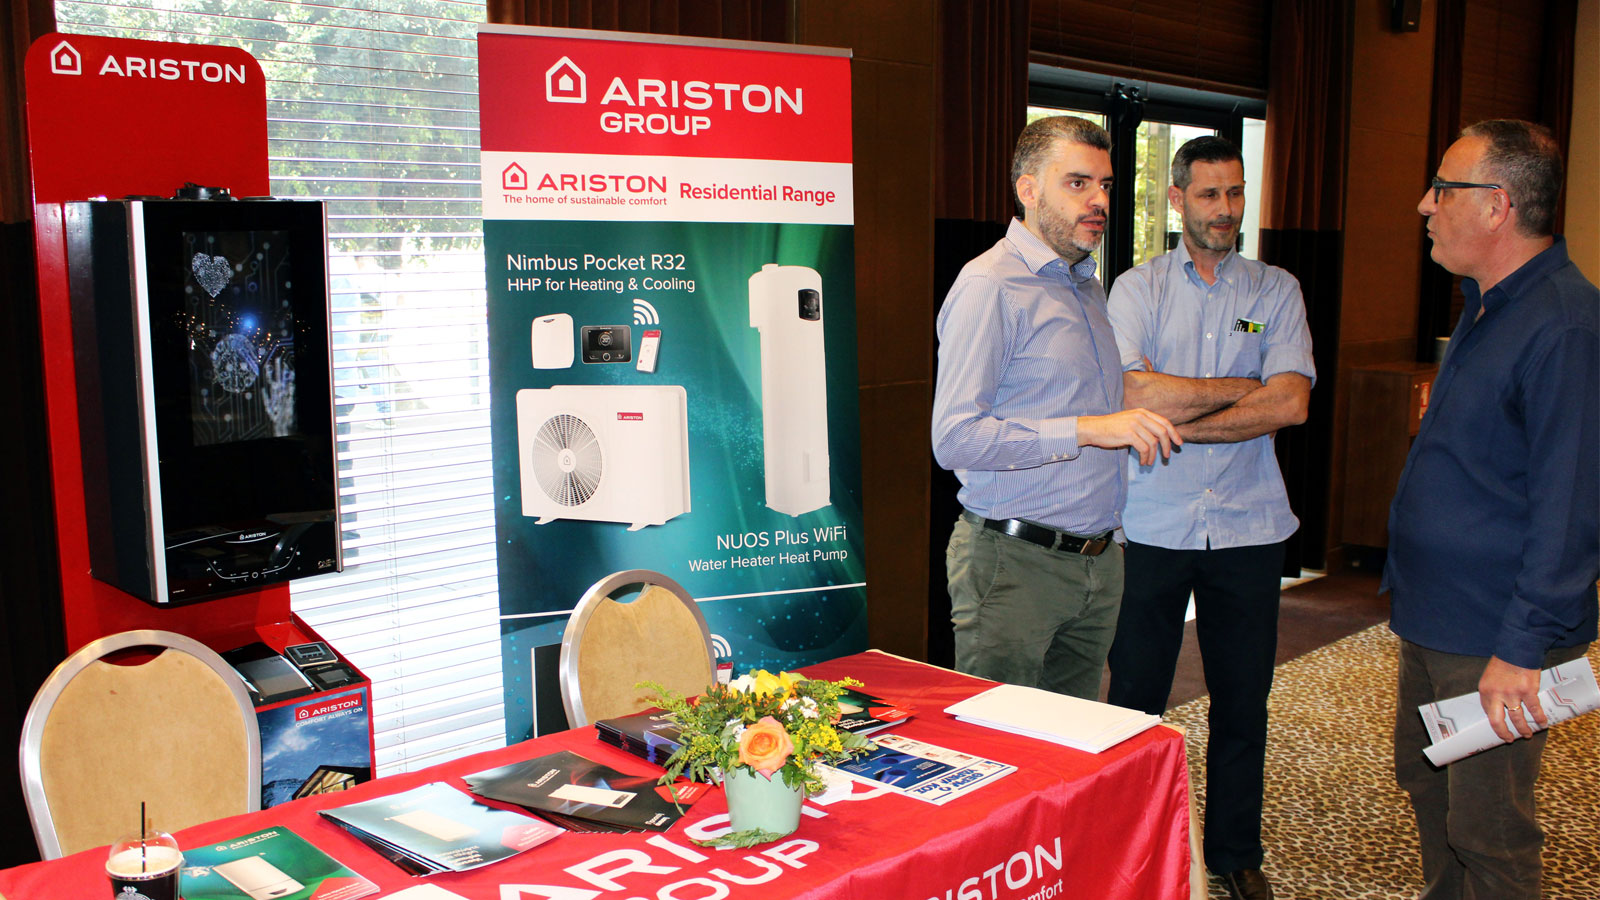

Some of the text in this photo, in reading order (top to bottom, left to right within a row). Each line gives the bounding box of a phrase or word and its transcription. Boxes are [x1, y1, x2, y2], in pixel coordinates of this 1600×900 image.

[99, 55, 246, 84] ARISTON
[600, 77, 803, 115] ARISTON
[600, 112, 711, 136] GROUP
[537, 173, 667, 193] ARISTON
[503, 194, 667, 206] The home of sustainable comfort
[680, 182, 836, 206] Residential Range
[507, 254, 686, 271] Nimbus Pocket R32
[508, 277, 695, 294] HHP for Heating & Cooling
[717, 525, 847, 551] NUOS Plus WiFi
[688, 549, 848, 572] Water Heater Heat Pump
[312, 699, 359, 716] ARISTON
[295, 715, 327, 728] COMFORT
[328, 709, 353, 720] ALWAYS
[229, 830, 278, 848] ARISTON
